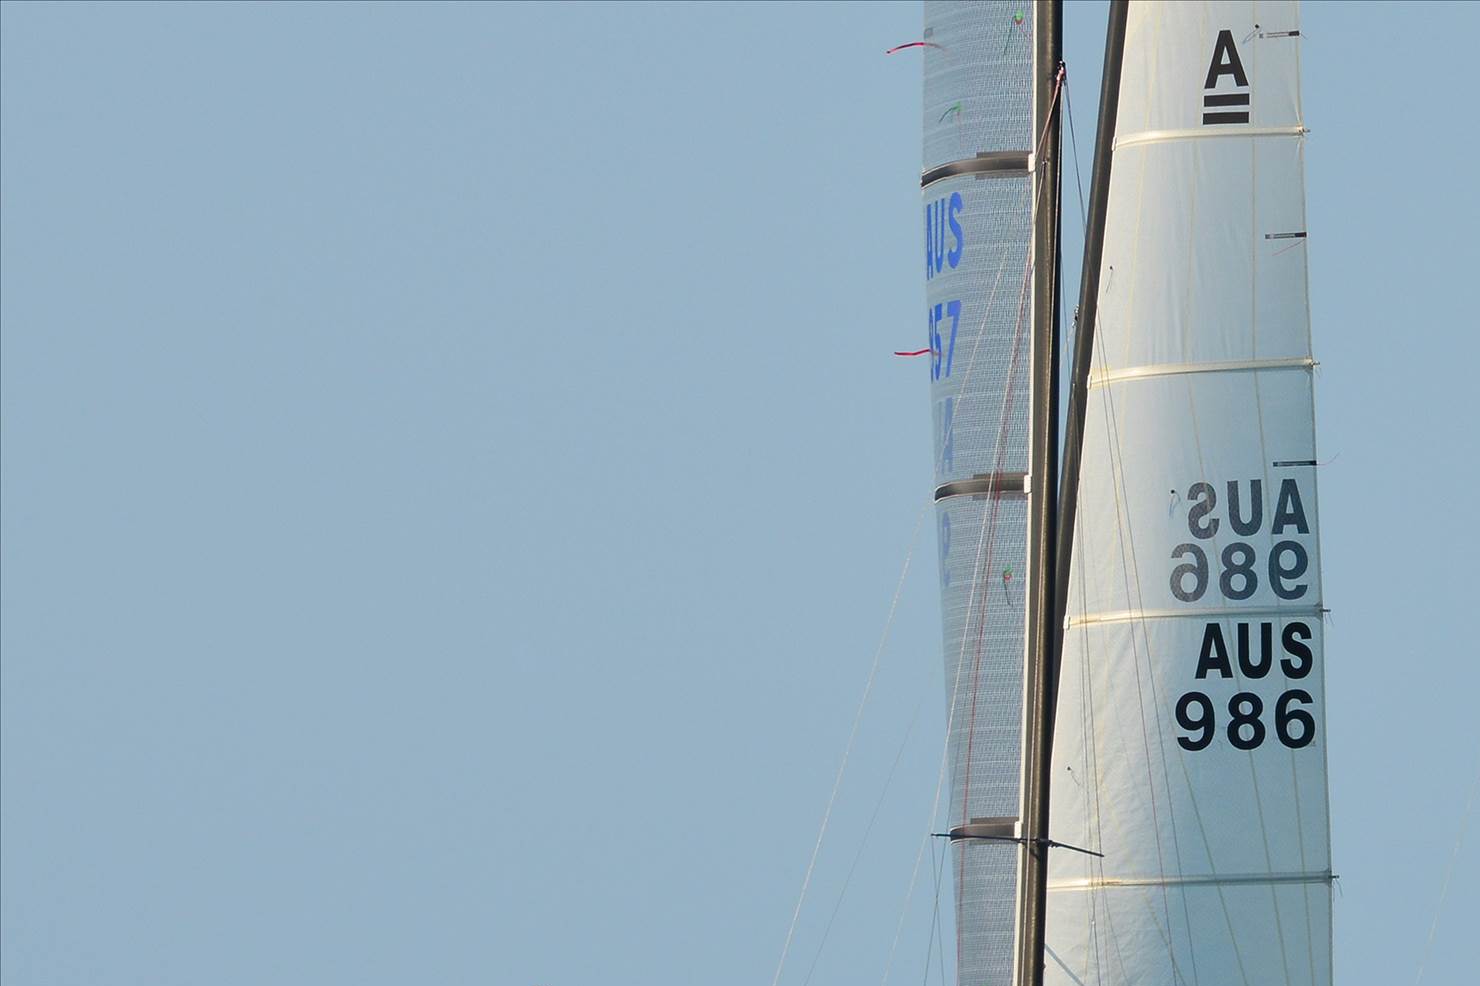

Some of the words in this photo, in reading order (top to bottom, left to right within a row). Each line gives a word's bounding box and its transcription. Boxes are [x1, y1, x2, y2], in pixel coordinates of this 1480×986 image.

[1203, 30, 1250, 90] A
[927, 192, 964, 280] AUS
[1195, 622, 1313, 679] AUS
[1175, 689, 1316, 751] 986
